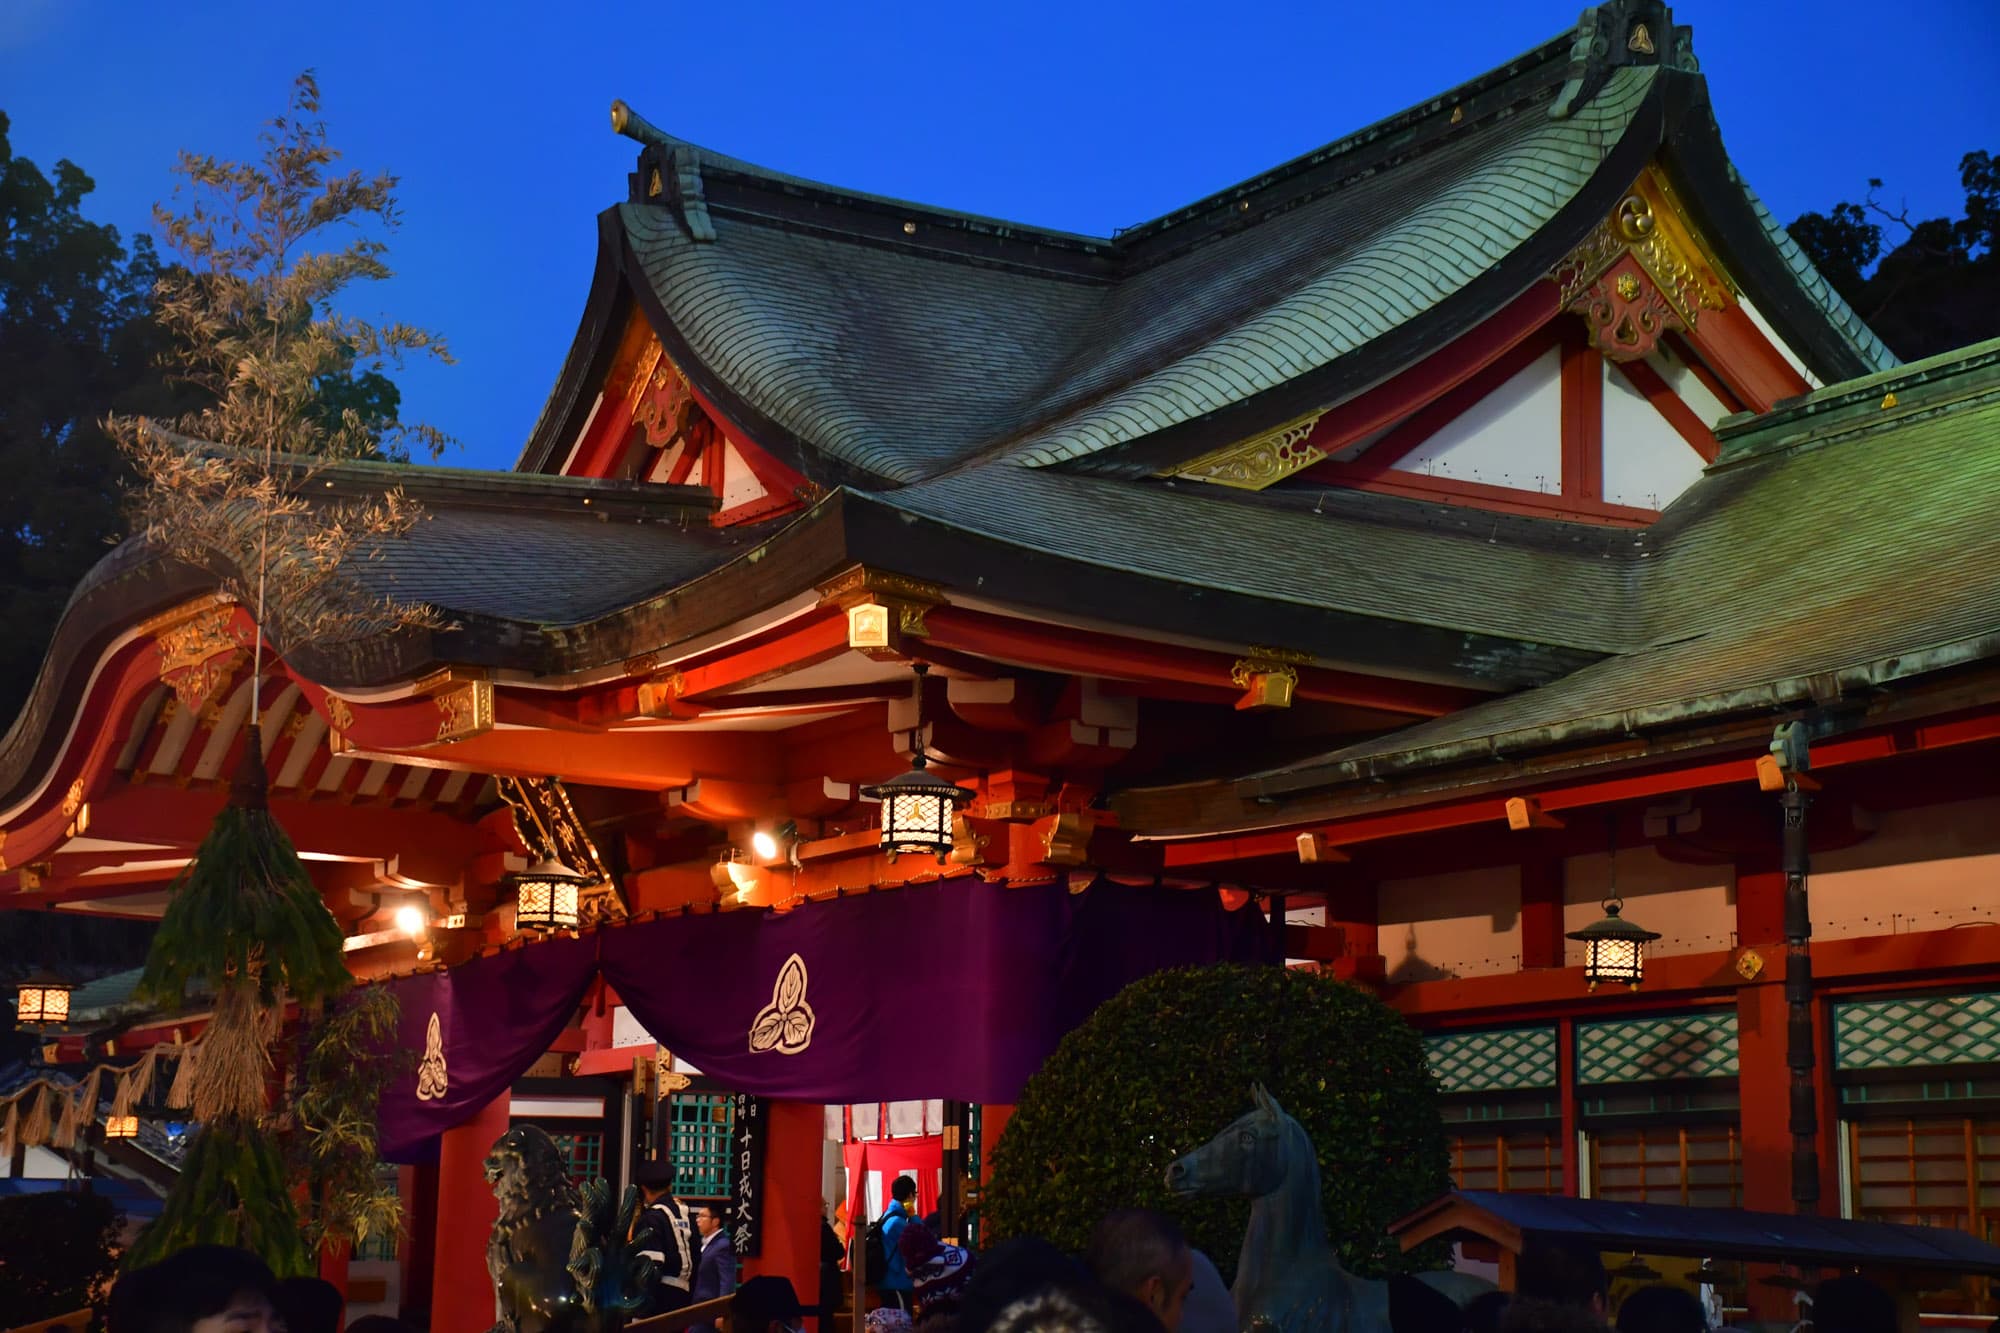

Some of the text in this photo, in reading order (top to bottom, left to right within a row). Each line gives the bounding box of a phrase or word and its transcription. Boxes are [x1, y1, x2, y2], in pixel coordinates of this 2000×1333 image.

[734, 1127, 753, 1253] 十日戎大祭
